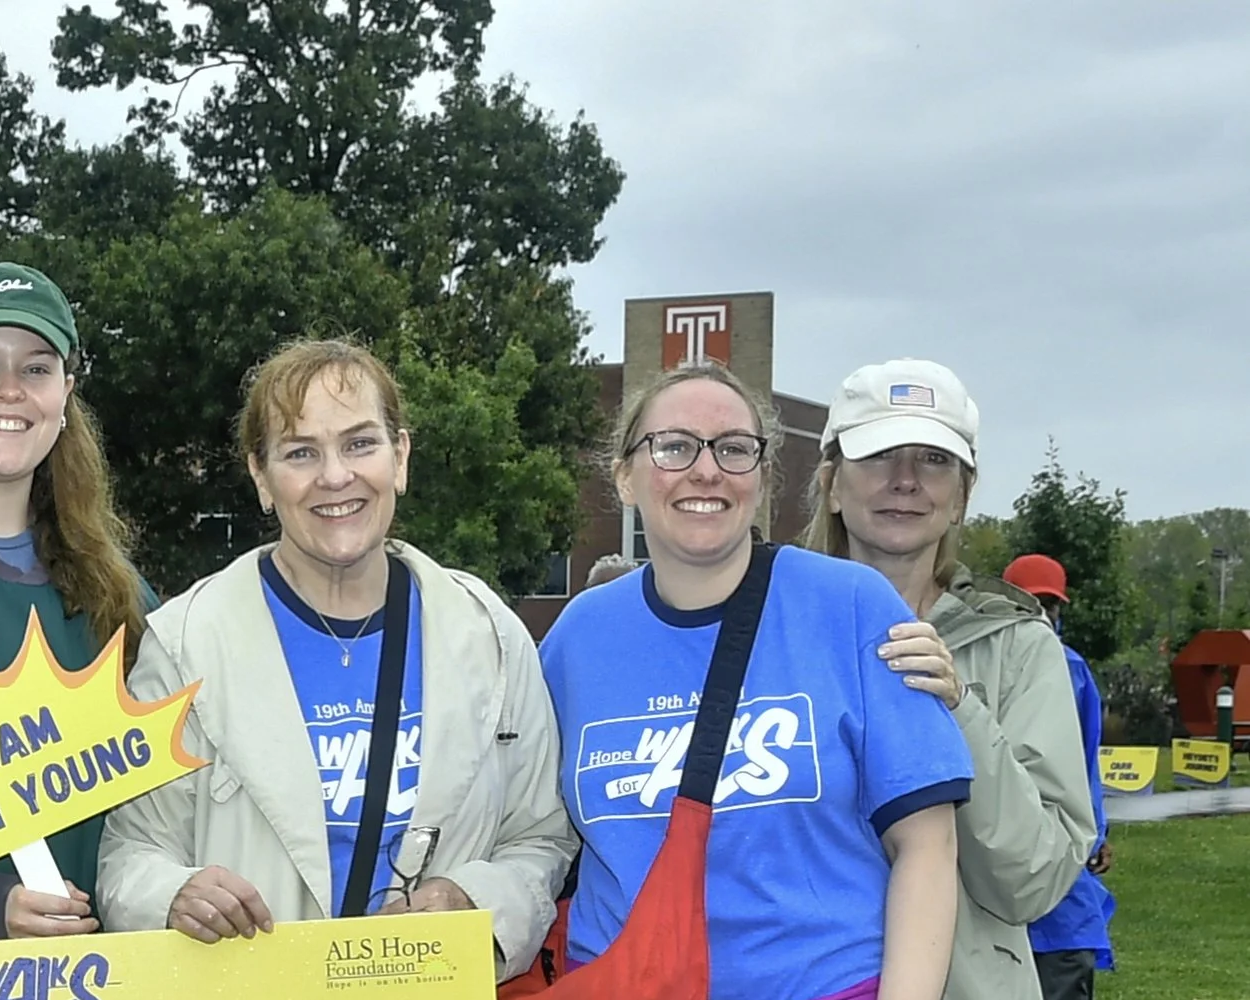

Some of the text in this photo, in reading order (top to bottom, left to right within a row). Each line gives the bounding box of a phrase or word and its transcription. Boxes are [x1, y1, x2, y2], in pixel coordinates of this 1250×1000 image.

[666, 304, 727, 369] T
[313, 702, 351, 719] 19th
[647, 694, 683, 711] 19th
[589, 750, 632, 766] Hope
[11, 728, 151, 815] YOUNG
[616, 780, 639, 795] for
[325, 937, 442, 963] ALS Hope
[326, 960, 416, 977] Foundation
[326, 981, 351, 990] Hope
[416, 975, 454, 983] horizon
